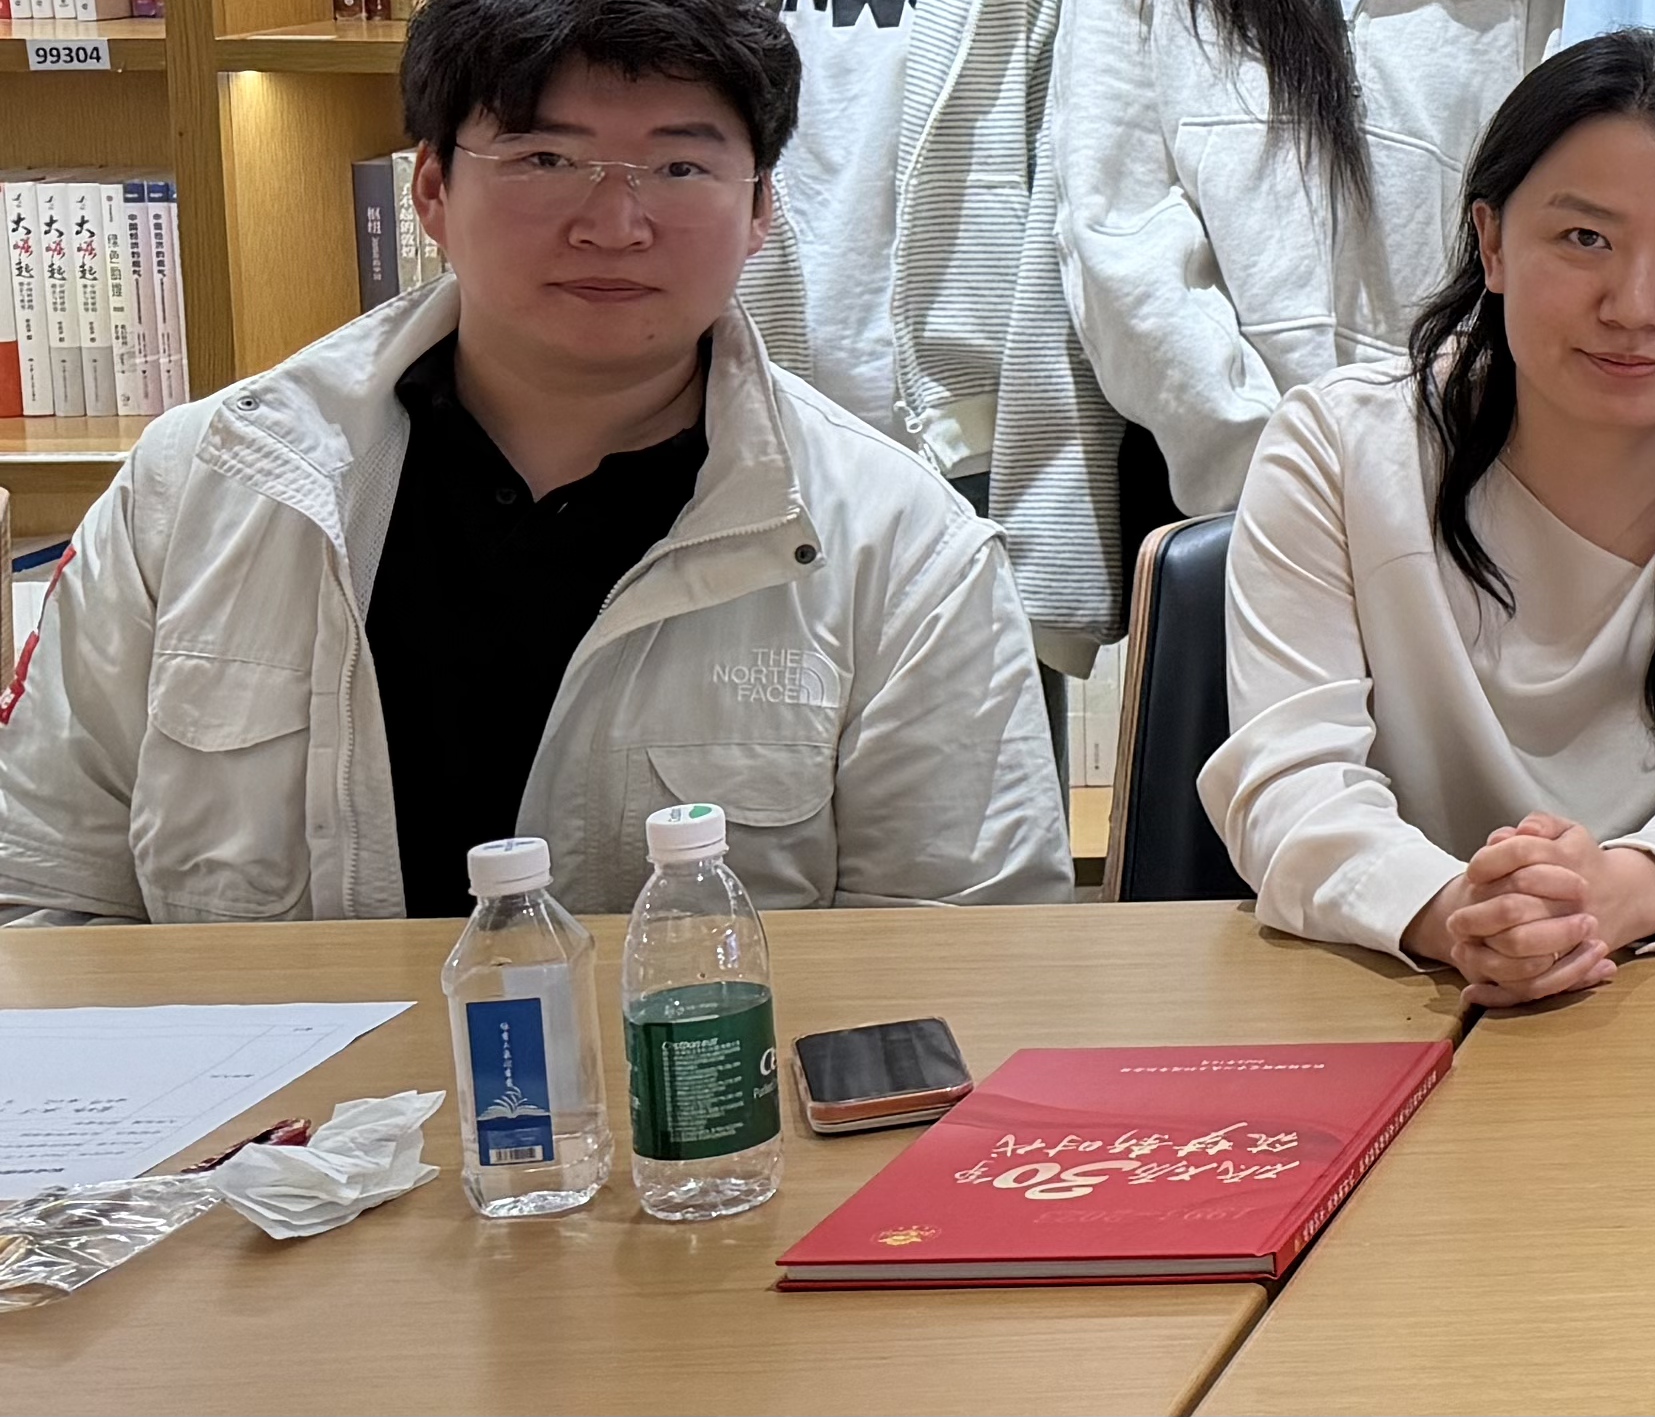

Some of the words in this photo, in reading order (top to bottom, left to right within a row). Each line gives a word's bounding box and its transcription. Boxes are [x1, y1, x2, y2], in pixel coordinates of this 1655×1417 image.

[35, 45, 103, 66] 99304
[10, 214, 35, 280] 大崛起
[43, 214, 67, 281] 大崛起
[75, 214, 98, 281] 大崛起
[752, 649, 801, 667] THE
[713, 664, 800, 685] NORTH
[737, 685, 799, 703] FACE
[991, 1122, 1299, 1159] 筑梦新时代
